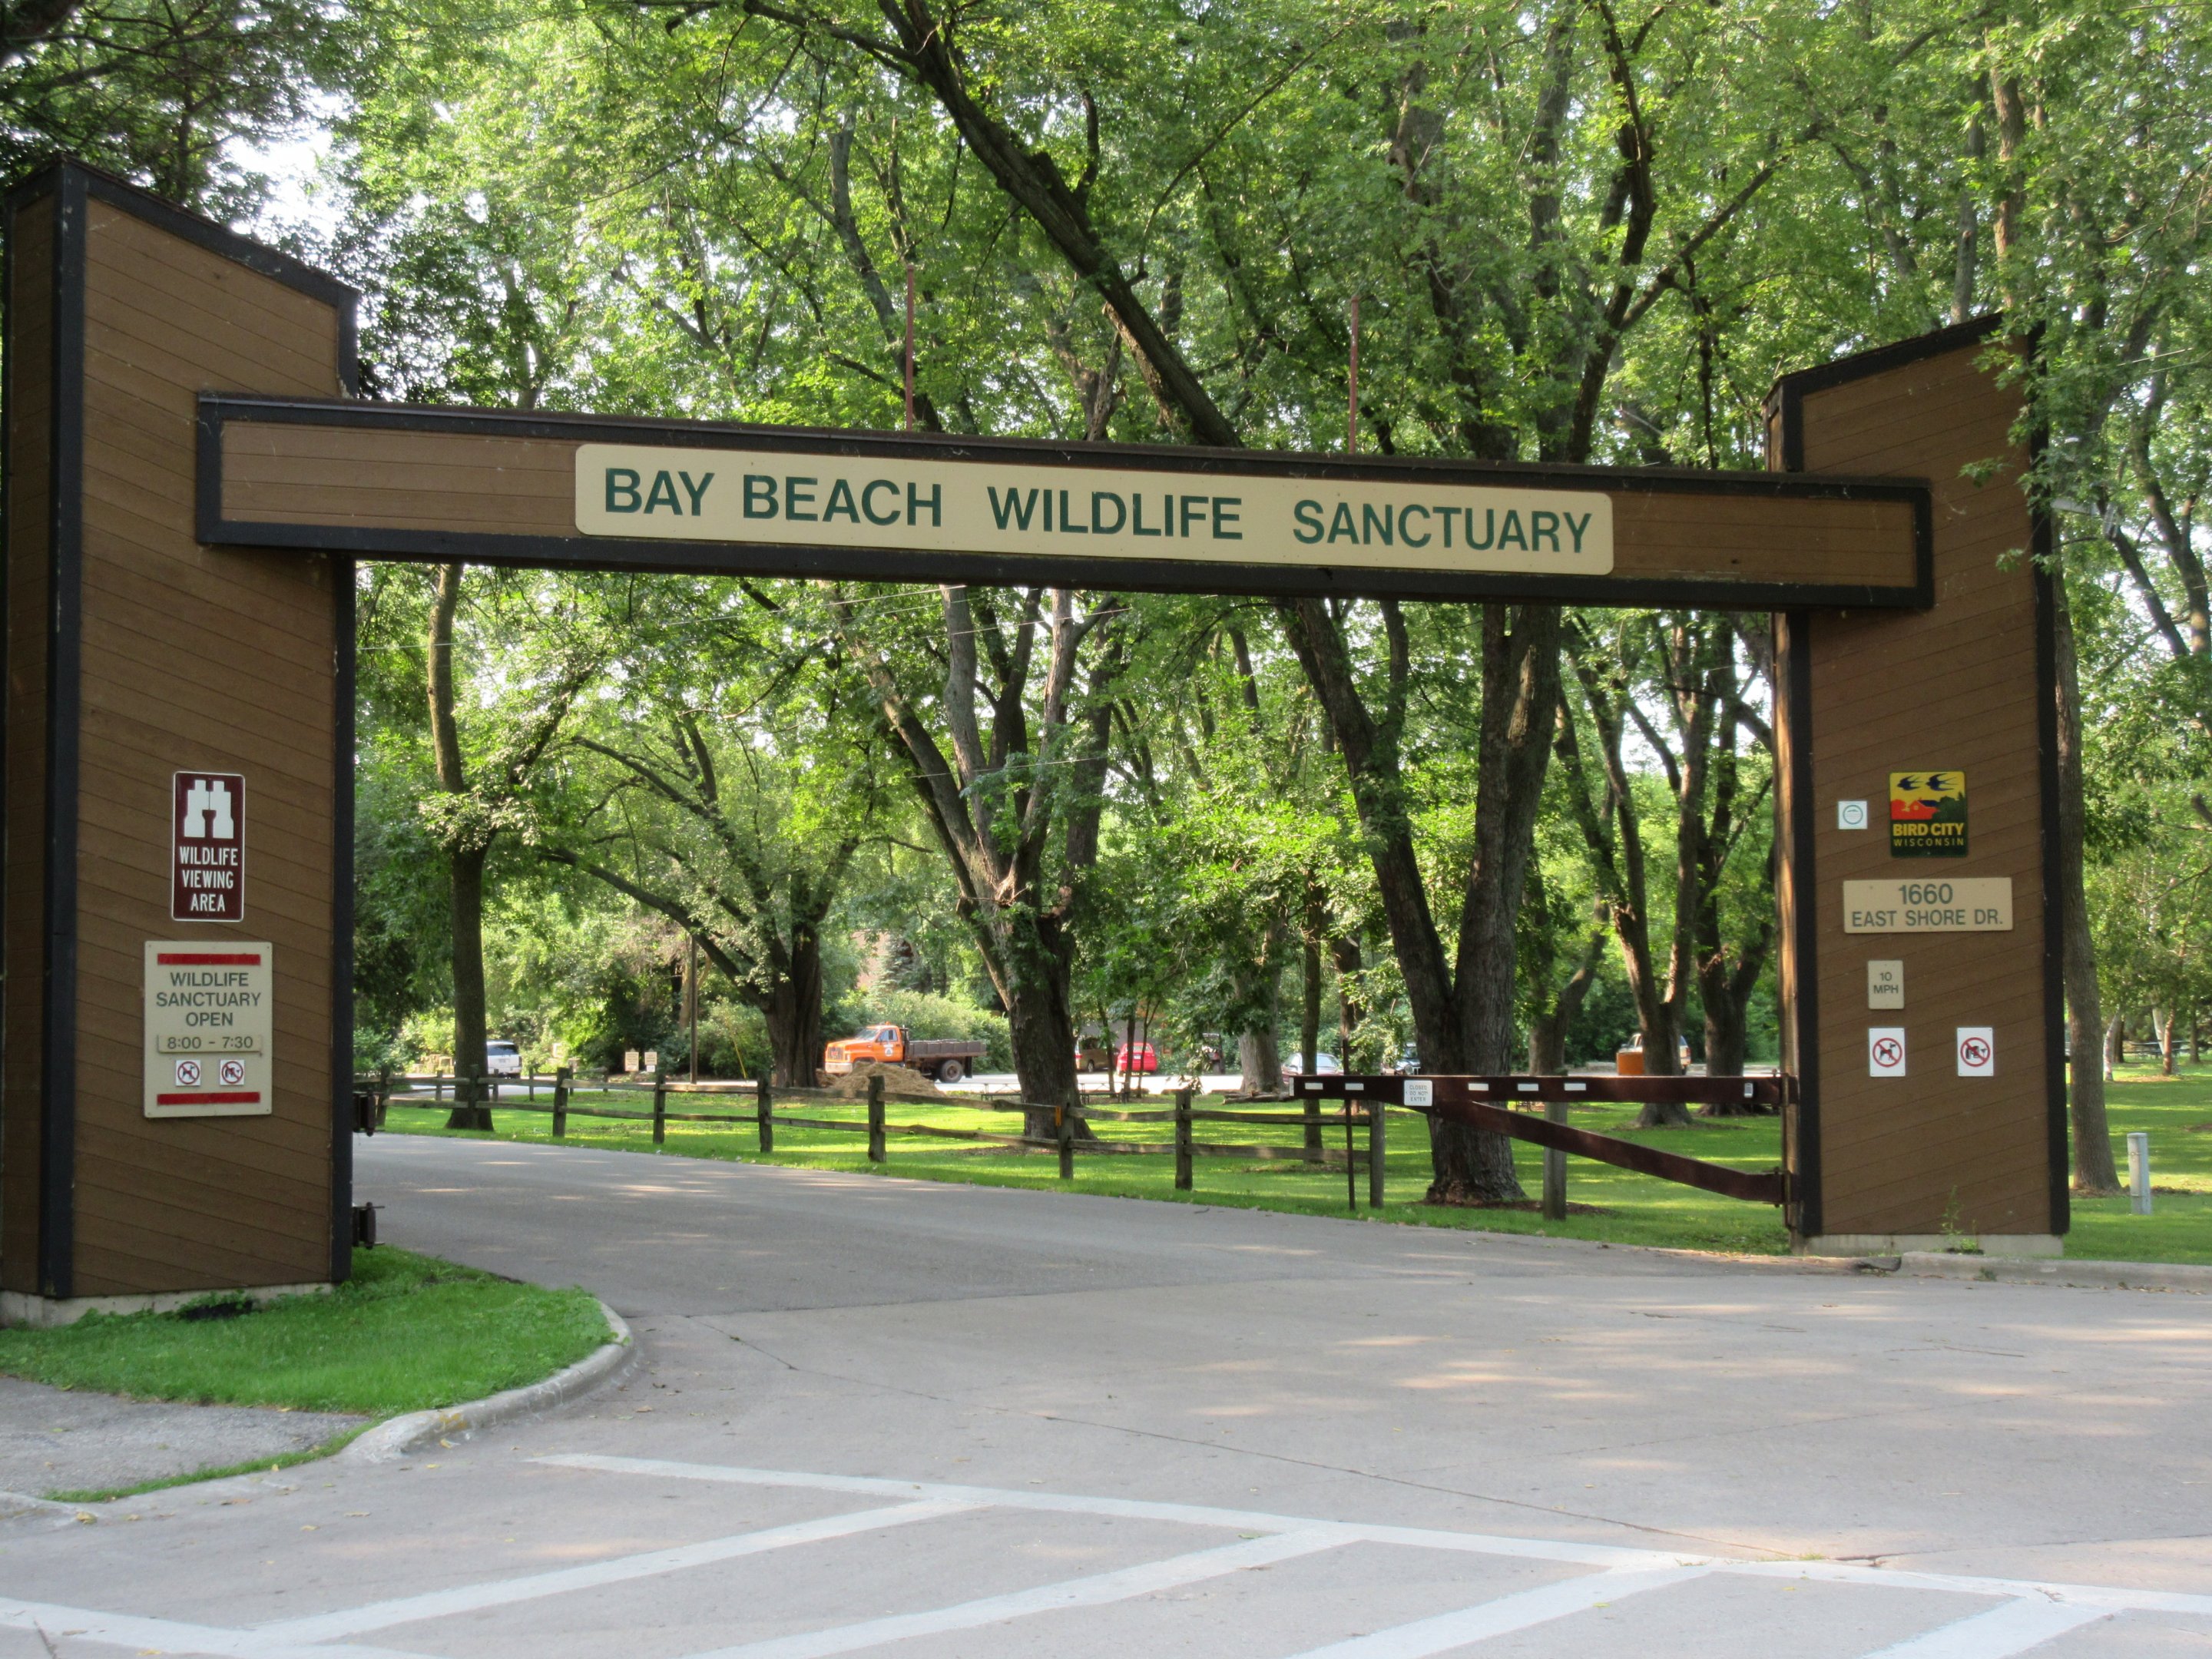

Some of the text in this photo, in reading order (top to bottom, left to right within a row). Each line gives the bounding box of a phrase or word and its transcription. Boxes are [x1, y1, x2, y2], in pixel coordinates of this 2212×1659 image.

[604, 467, 1592, 554] BAY BEACH WILDLIFE SANCTUARY
[1892, 823, 1964, 836] BIRD CITY
[1893, 838, 1964, 846] WISCONSIN
[179, 846, 238, 866] WILDLIFE
[182, 869, 234, 889] VIEWING
[1898, 883, 1953, 905] 1660
[190, 893, 225, 912] AREA
[1852, 909, 2003, 927] EAST SHORE DR.
[170, 972, 249, 986] WILDLIFE
[1879, 972, 1892, 982] 10
[1873, 985, 1899, 994] MPH
[156, 992, 261, 1007] SANCTUARY
[185, 1012, 233, 1026] OPEN
[167, 1037, 202, 1050] 8:00
[222, 1036, 253, 1049] 7:30
